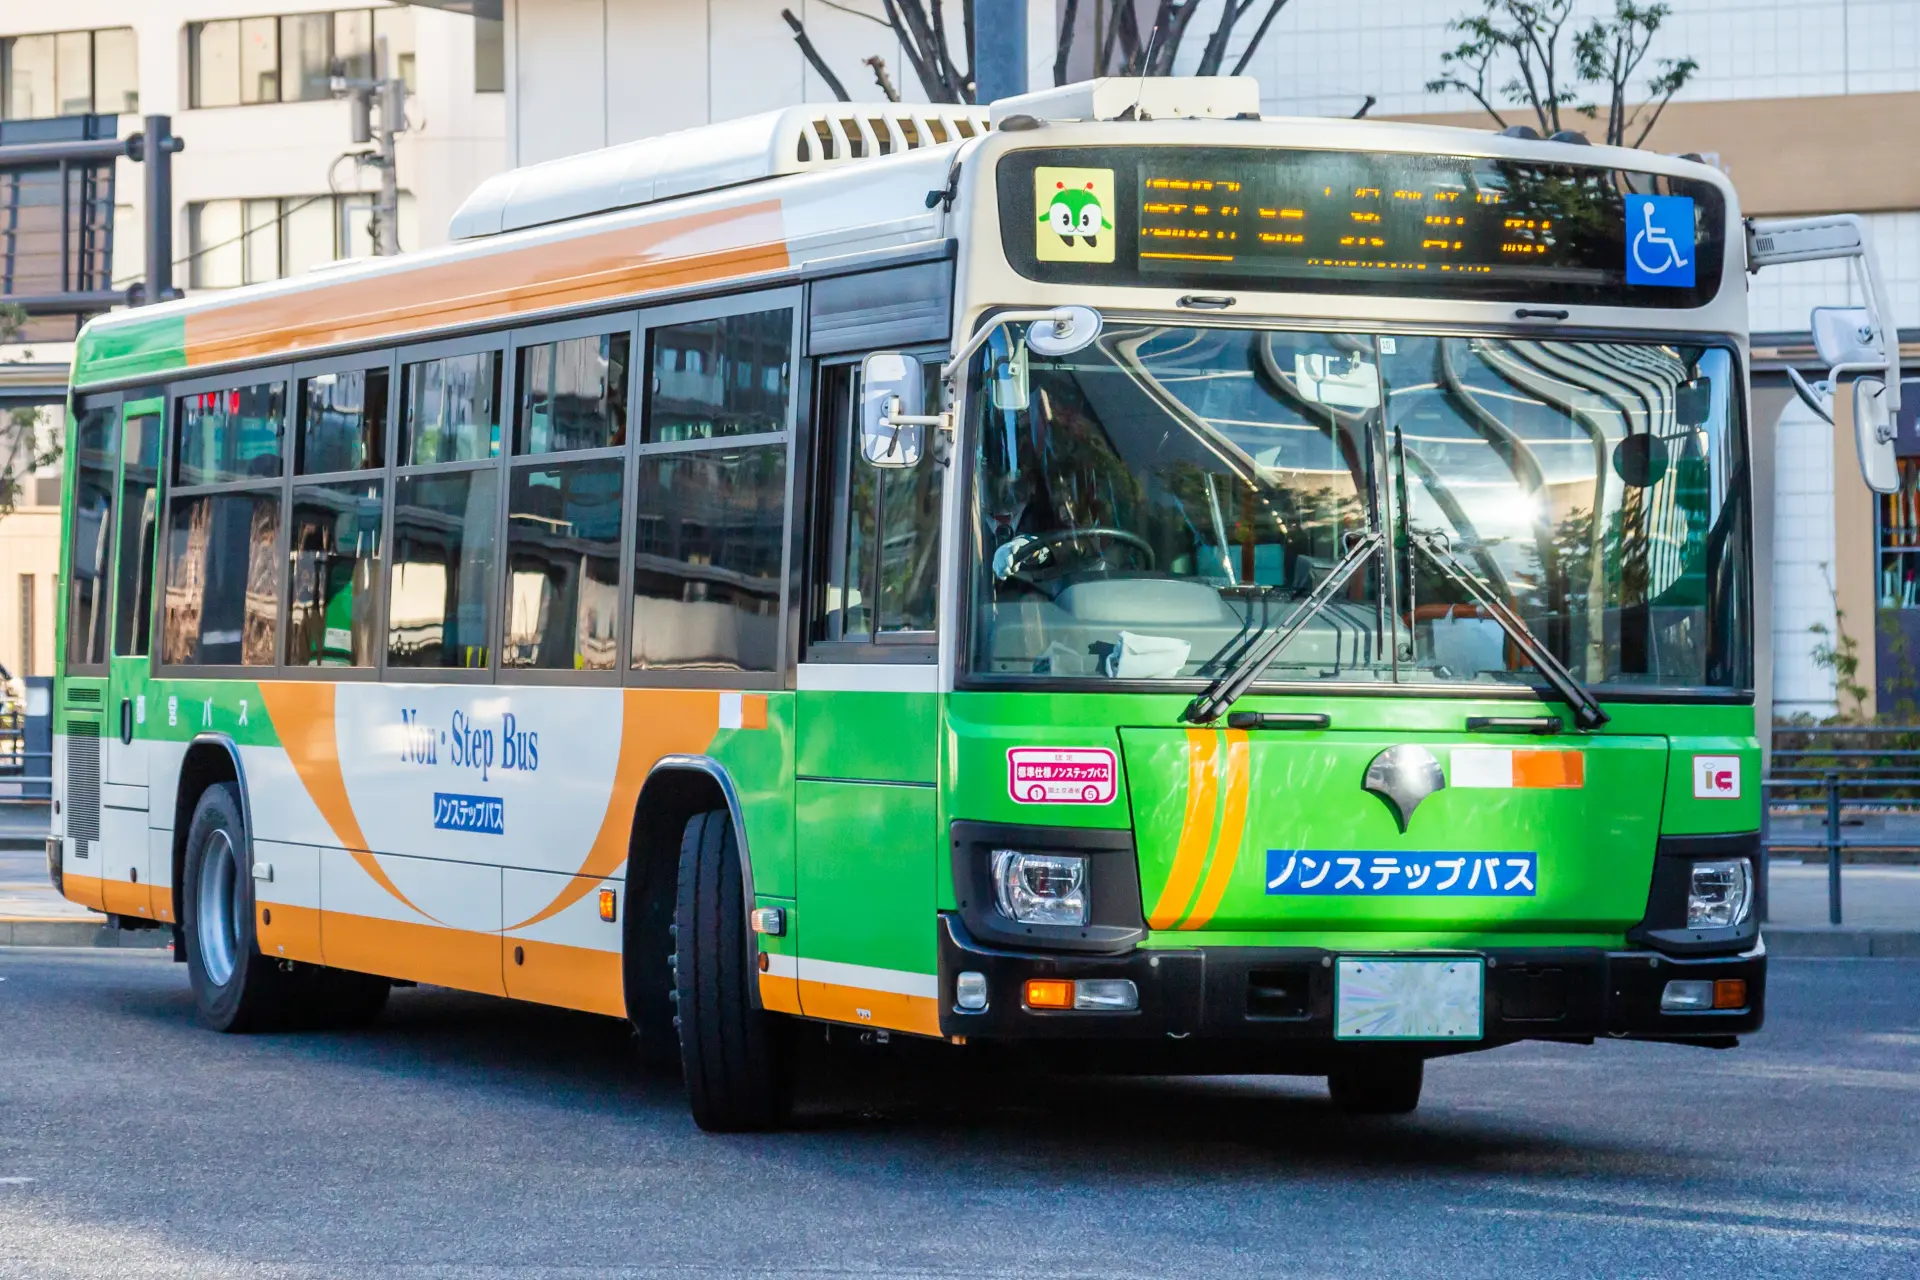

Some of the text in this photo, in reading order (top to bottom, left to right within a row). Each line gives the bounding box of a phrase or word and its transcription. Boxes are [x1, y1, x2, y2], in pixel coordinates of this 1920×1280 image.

[136, 695, 248, 727] 営バス
[501, 712, 538, 771] Bus
[1087, 790, 1094, 799] 5
[434, 798, 504, 830] ノンステップバス
[1267, 855, 1535, 892] ノンステップバス
